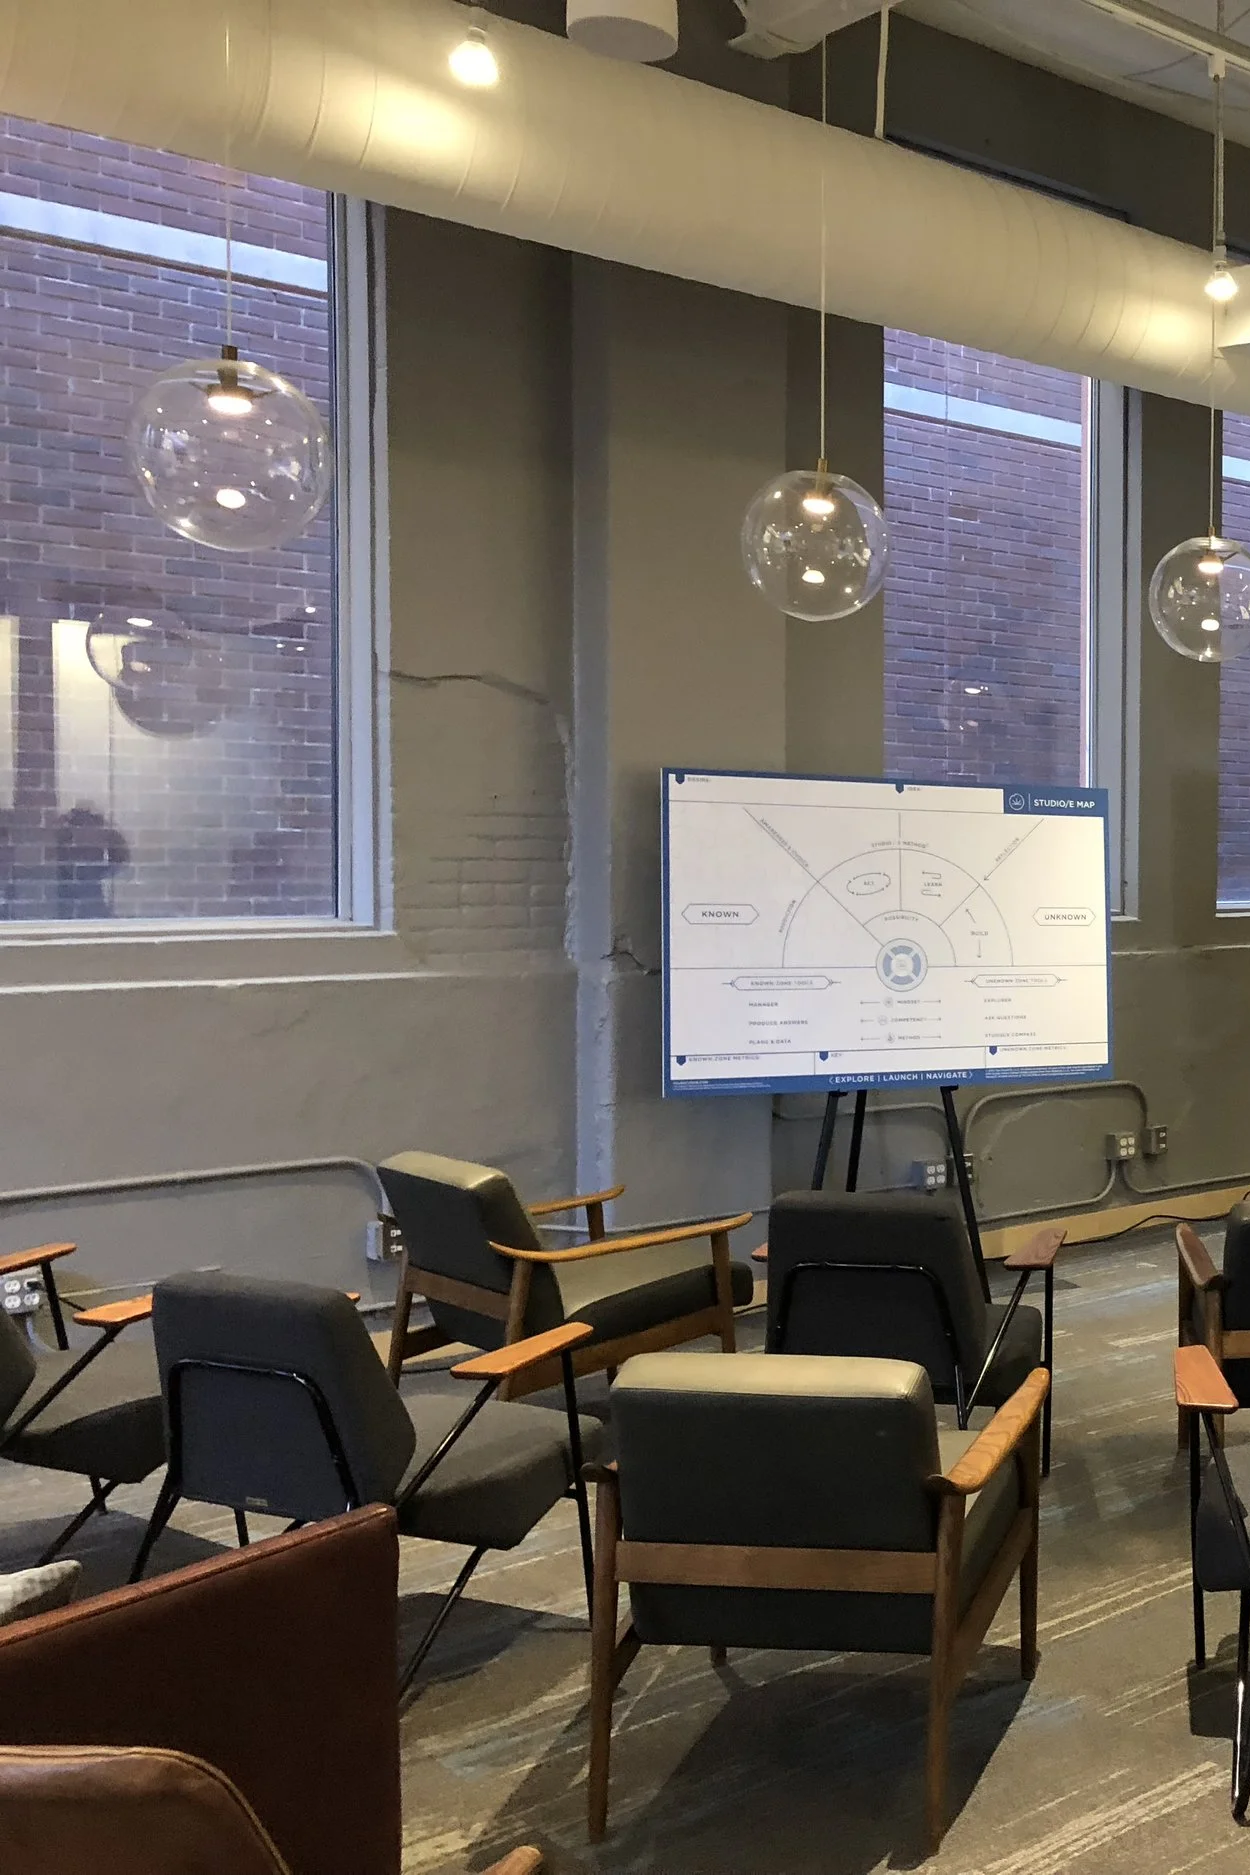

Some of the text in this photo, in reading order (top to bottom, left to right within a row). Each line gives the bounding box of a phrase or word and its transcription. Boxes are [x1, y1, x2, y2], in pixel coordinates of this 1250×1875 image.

[1033, 799, 1096, 809] STUDIO/E MAP
[1044, 913, 1087, 921] UNKNOWN
[835, 1072, 968, 1083] EXPLORE LAUNCH NAVIGATE
